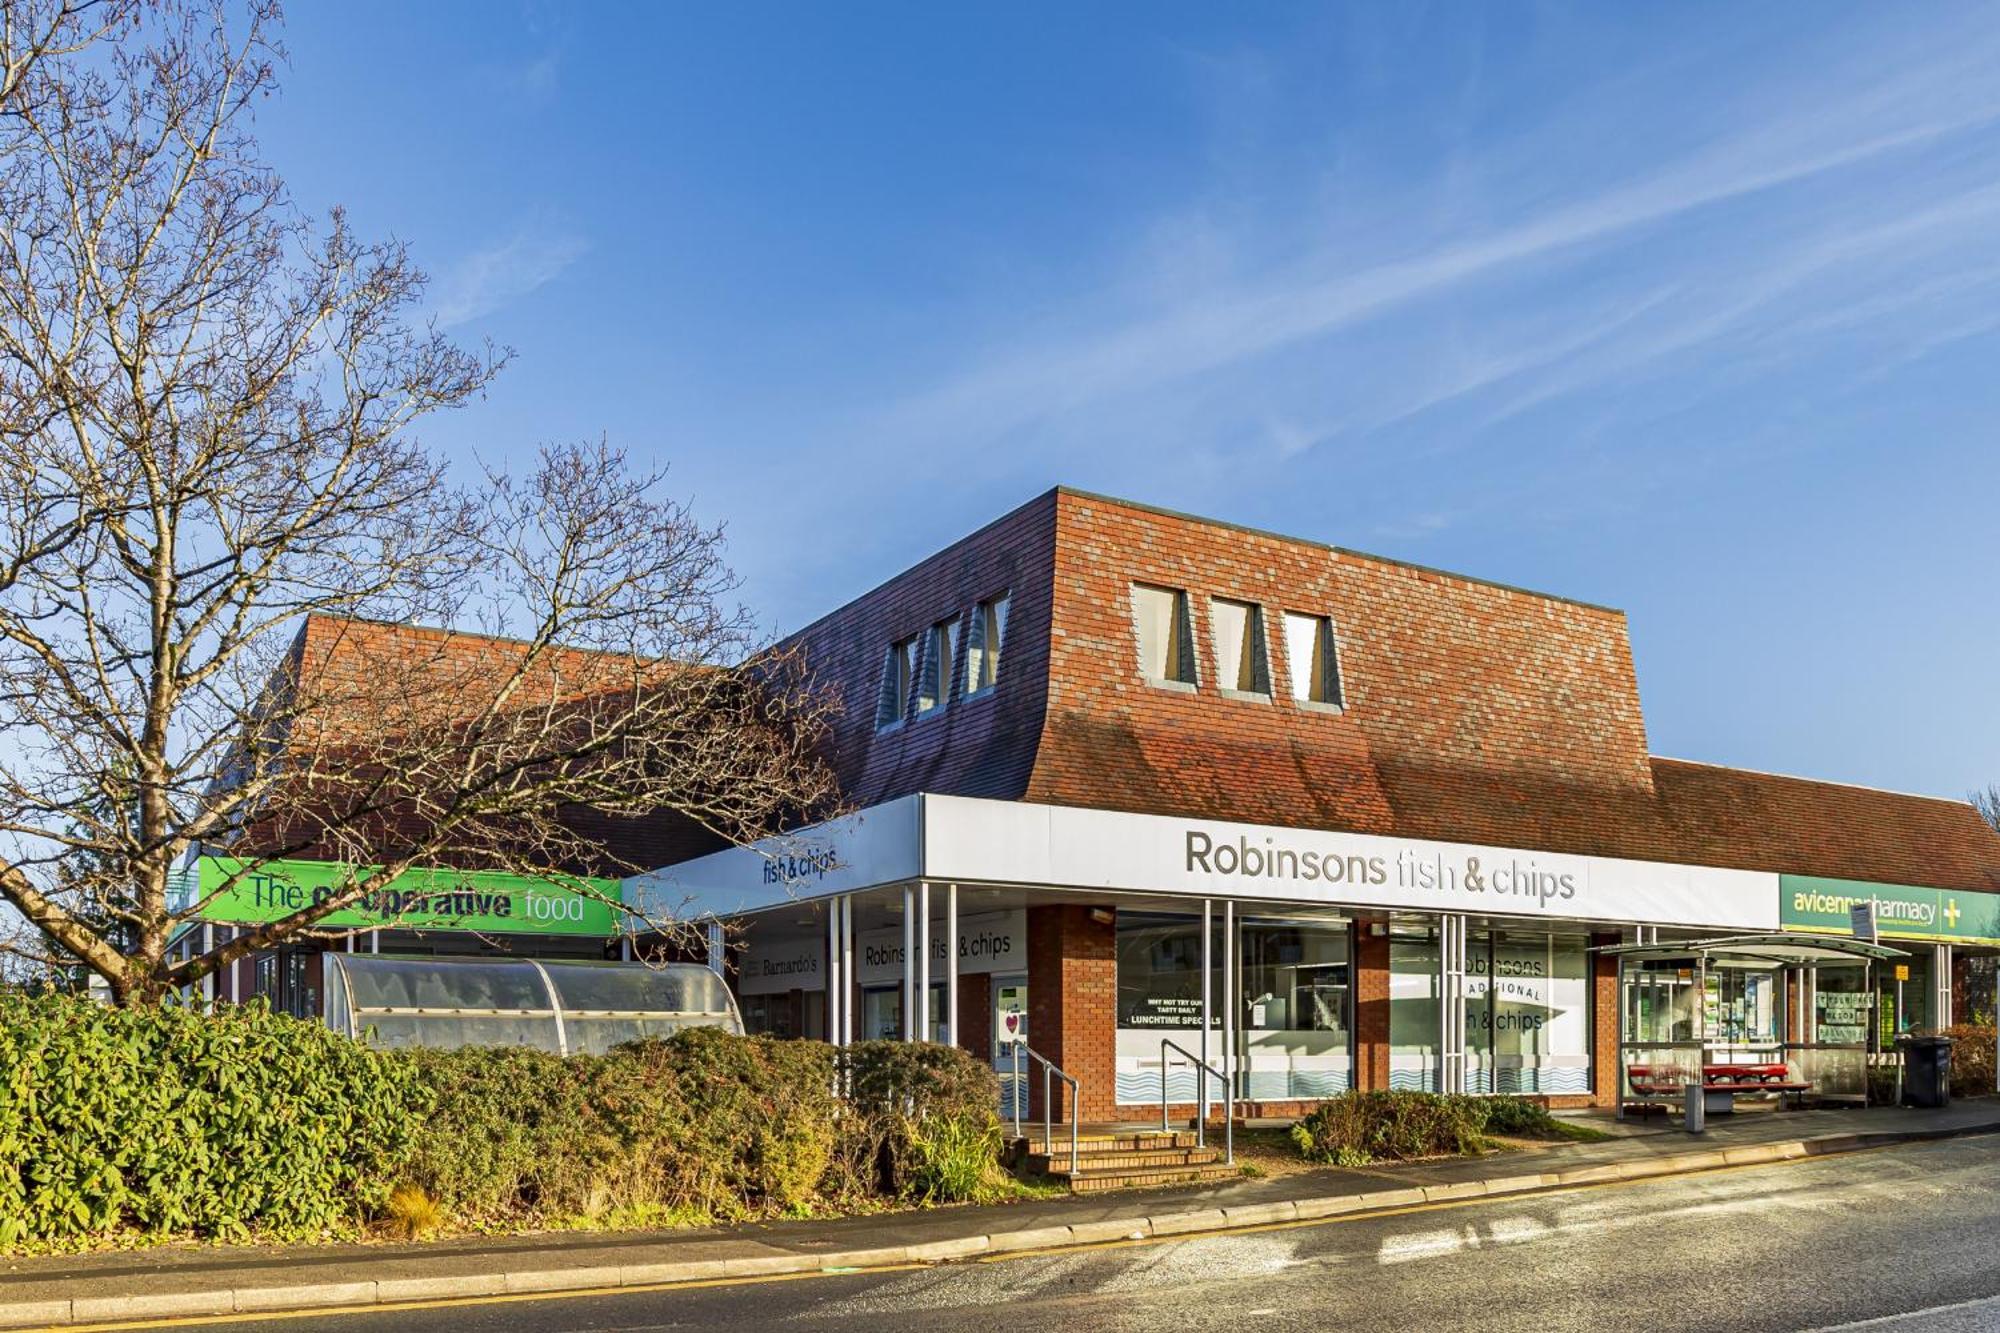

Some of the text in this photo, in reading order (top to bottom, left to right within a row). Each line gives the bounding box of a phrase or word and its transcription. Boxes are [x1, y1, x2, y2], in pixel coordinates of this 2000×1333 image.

[763, 848, 836, 884] fish & chips
[1186, 831, 1576, 908] Robinsons fish & chips
[248, 874, 304, 910] The
[525, 889, 584, 921] food
[763, 952, 817, 976] Barnardo's
[866, 944, 922, 966] Robinsn
[959, 936, 968, 957] &
[971, 932, 1011, 960] chips
[1131, 1016, 1221, 1025] LUNCHTIME SPECLS
[1496, 1010, 1542, 1034] chips
